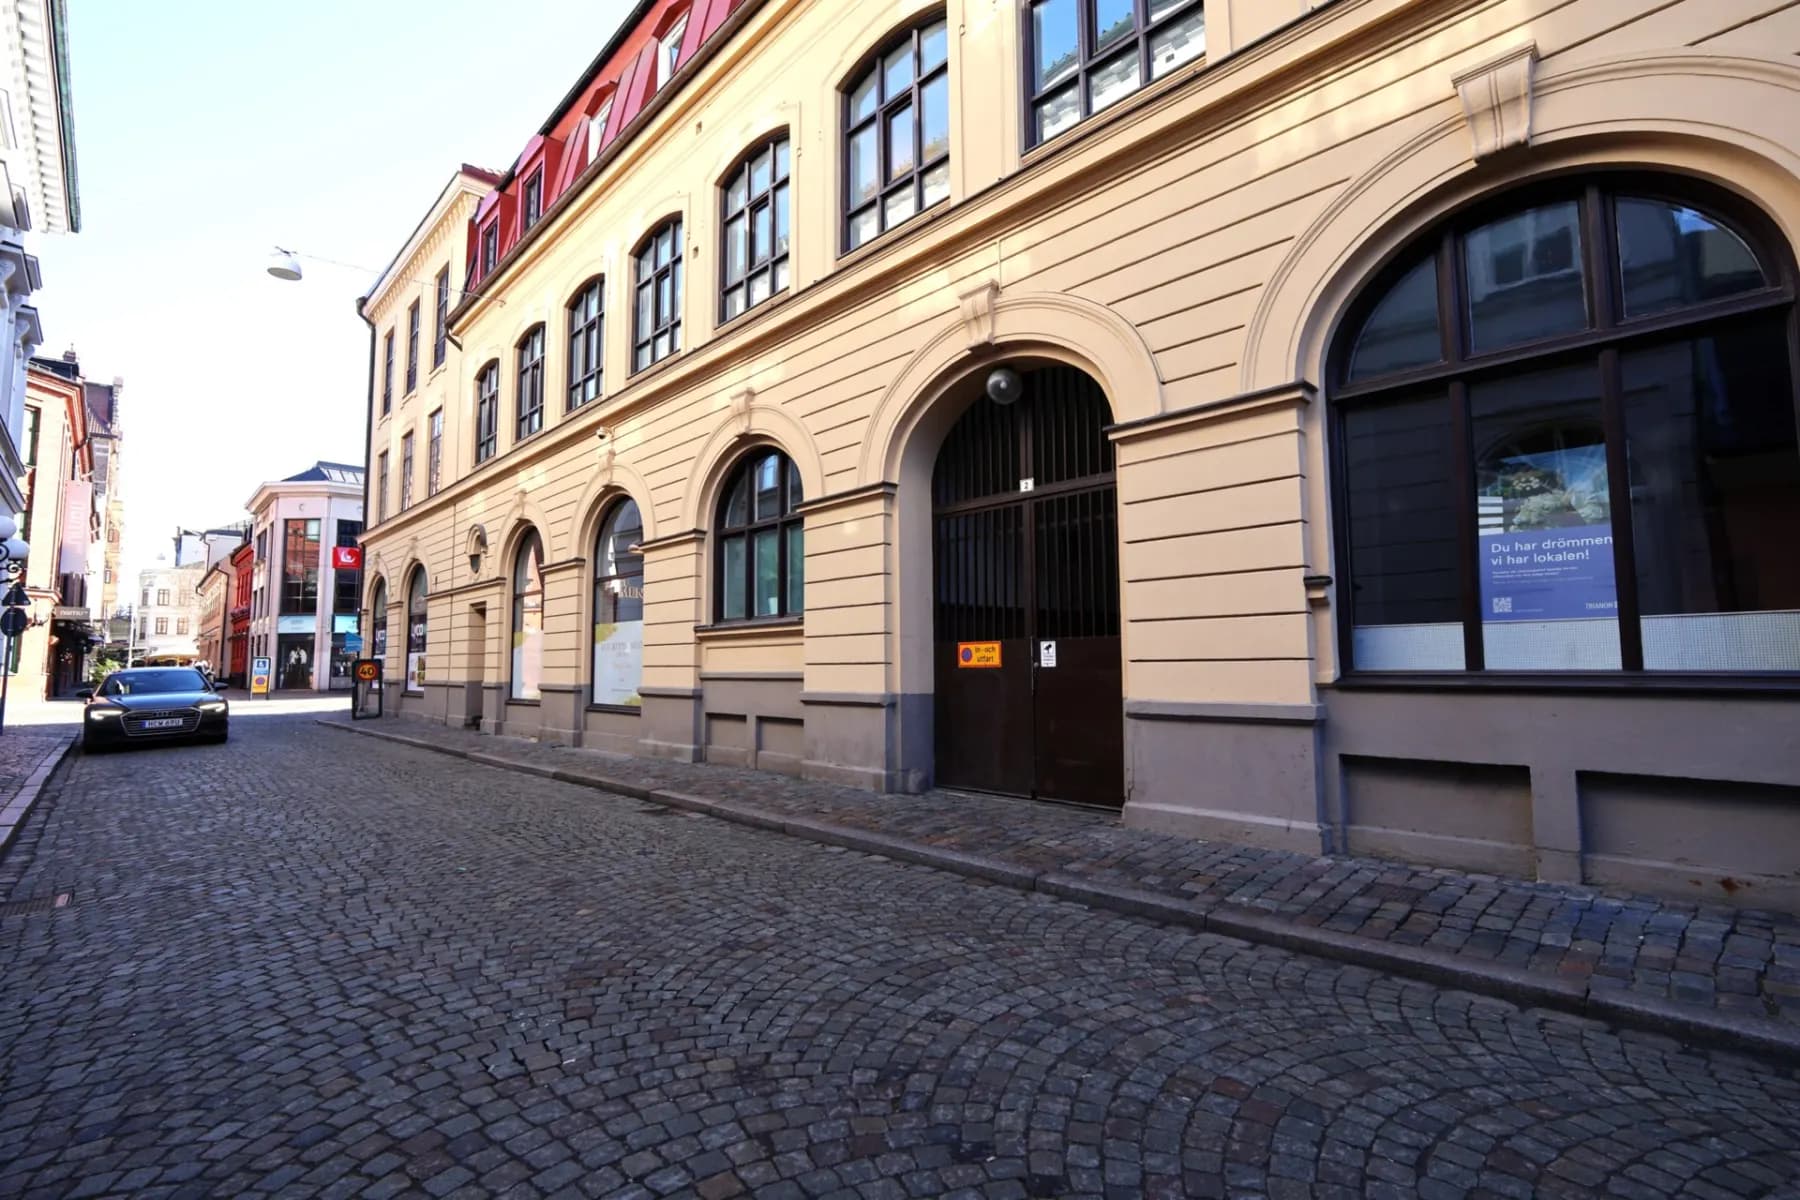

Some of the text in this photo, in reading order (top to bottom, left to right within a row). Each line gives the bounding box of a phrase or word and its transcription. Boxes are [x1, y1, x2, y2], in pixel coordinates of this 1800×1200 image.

[1491, 536, 1613, 553] Du har drömmen
[1491, 549, 1590, 565] vi har lokalen!
[976, 655, 994, 663] utfart
[360, 666, 375, 676] 40
